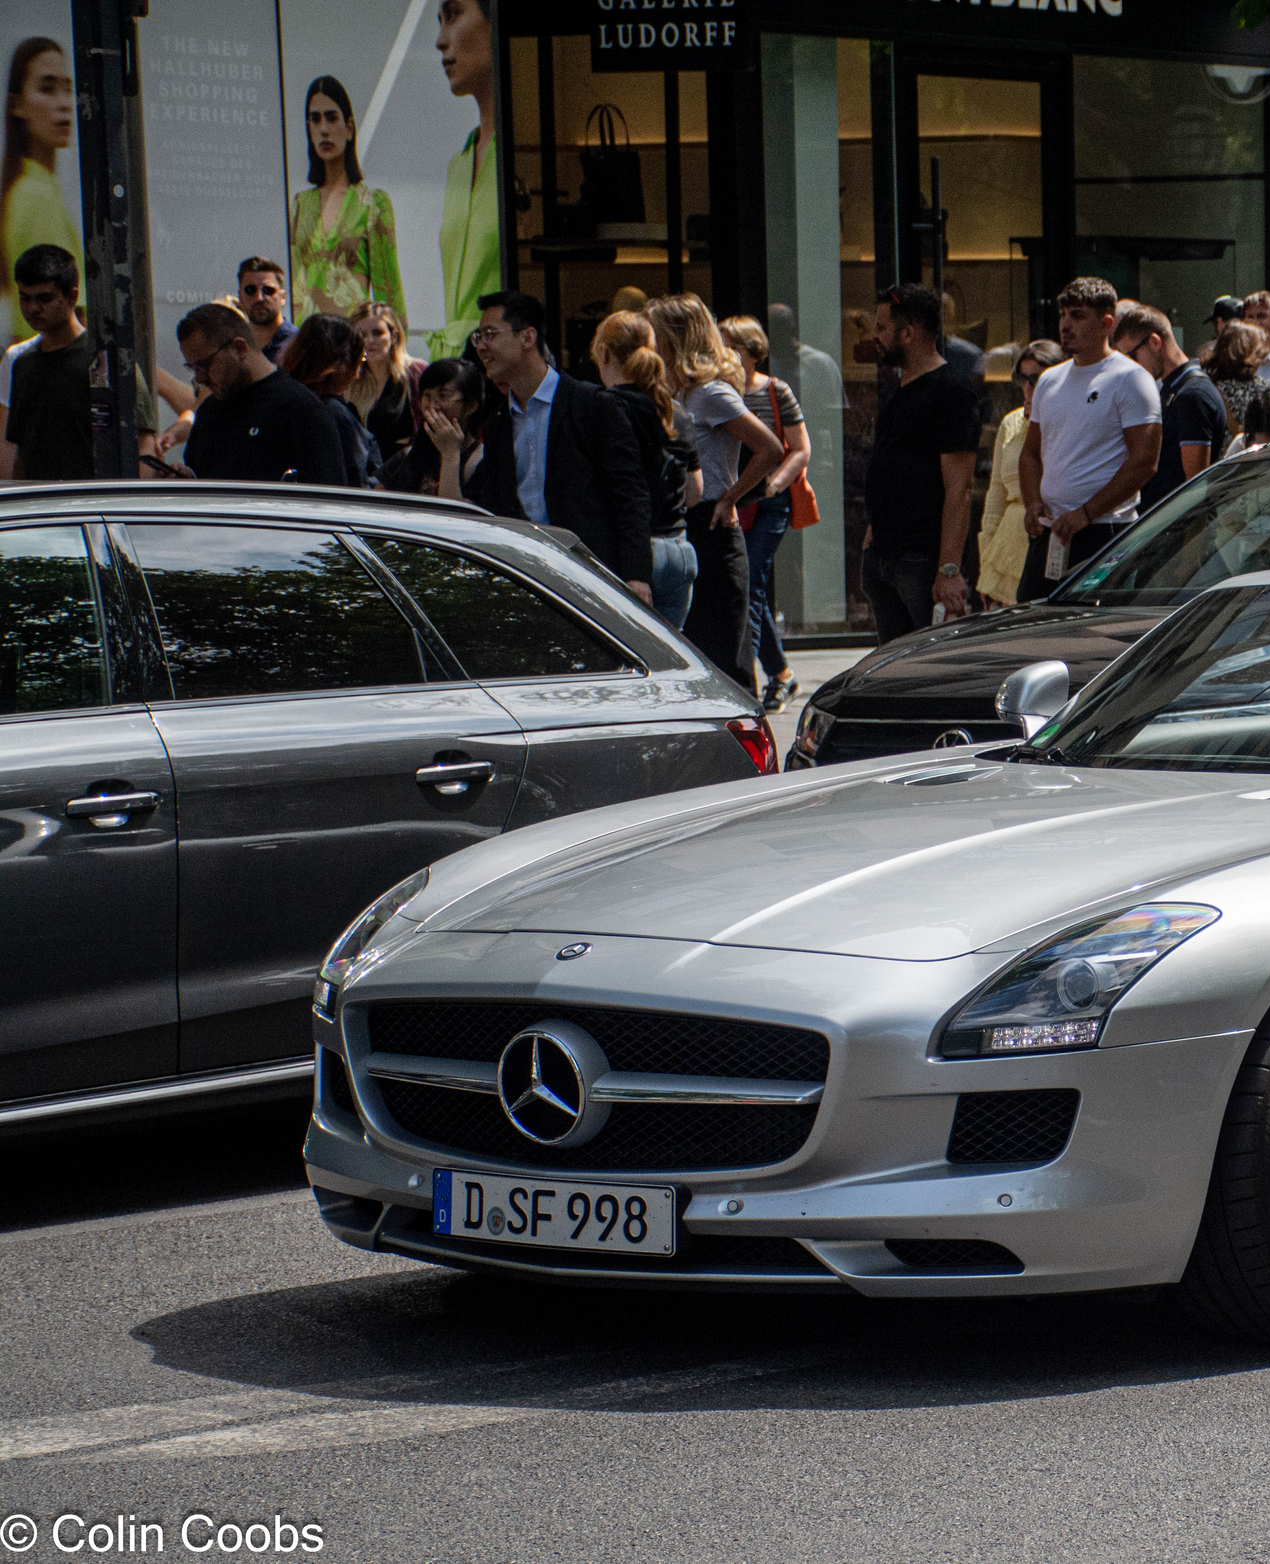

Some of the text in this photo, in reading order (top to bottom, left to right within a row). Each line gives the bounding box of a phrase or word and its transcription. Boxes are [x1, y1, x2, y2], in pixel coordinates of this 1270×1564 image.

[161, 35, 249, 57] THE NEW
[598, 20, 736, 49] LUDORFF
[149, 57, 264, 82] HALLHUBER
[158, 81, 258, 103] SHOPPING
[149, 102, 269, 127] EXPERIENCE
[438, 1208, 447, 1224] D
[464, 1180, 648, 1244] D SF 998
